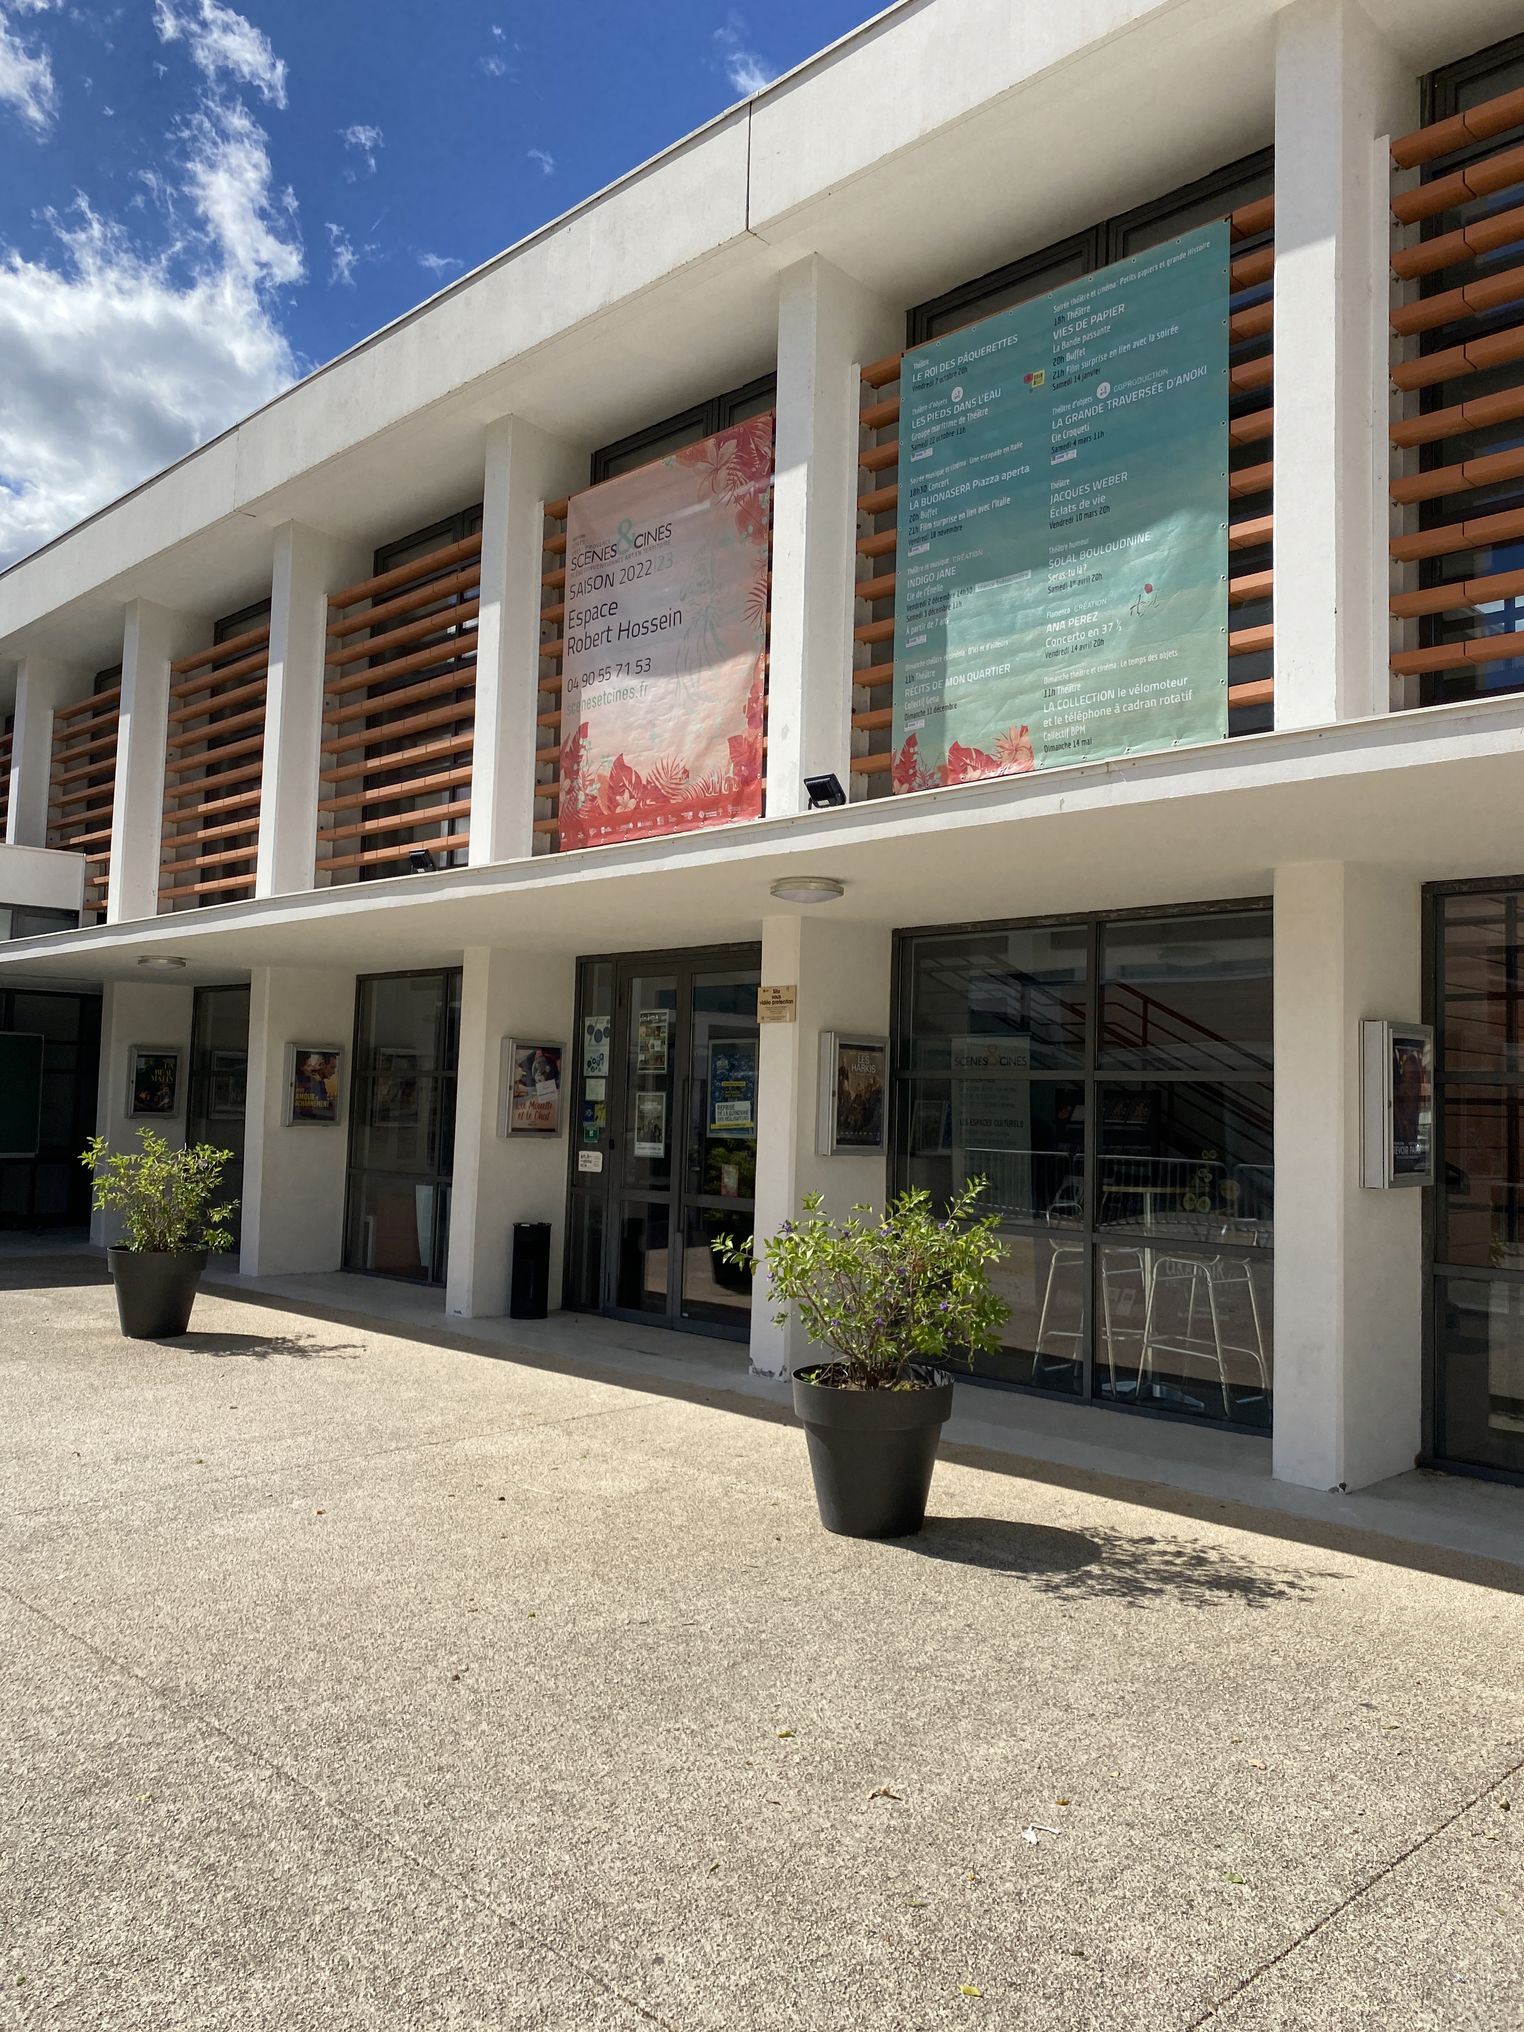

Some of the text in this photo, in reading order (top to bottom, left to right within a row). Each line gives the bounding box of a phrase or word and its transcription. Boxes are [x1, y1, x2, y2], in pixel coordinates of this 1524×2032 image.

[1053, 302, 1124, 340] VIES DE PAPIER
[1054, 305, 1090, 326] 18h Théâtre
[1052, 325, 1110, 353] La Bande passante
[1052, 367, 1064, 380] 21h
[1066, 363, 1079, 375] Film
[1081, 353, 1107, 369] surprise
[1109, 348, 1117, 358] en
[1118, 343, 1130, 354] lien
[1132, 336, 1146, 349] avec
[1148, 333, 1154, 343] la
[1156, 324, 1178, 340] soirée
[912, 333, 1017, 383] LE ROI DES PÂQUERETTES
[1053, 346, 1085, 367] 20h Buffet
[1052, 376, 1072, 391] Samedi
[1074, 373, 1080, 383] 14
[1081, 367, 1100, 382] janvier
[911, 415, 925, 429] LES
[926, 405, 951, 424] PIEDS
[953, 396, 976, 414] DANS
[978, 387, 1001, 405] L'EAU
[1052, 416, 1063, 430] LA
[1065, 401, 1103, 425] GRANDE
[1107, 381, 1163, 410] TRAVERSÉE
[1166, 364, 1206, 389] D'ANOKI
[1051, 429, 1104, 454] Samedi 4 mars 11h
[909, 464, 1029, 511] LA BUONASERA Piazza aperta
[928, 477, 949, 492] Concert
[1050, 470, 1127, 504] JACQUES WEBER
[1049, 504, 1110, 530] Vendredi 10 mars 20h
[1050, 493, 1105, 519] Éclats de vie
[570, 544, 617, 571] SCENES
[616, 514, 635, 557] &
[633, 521, 672, 550] CINES
[1048, 530, 1151, 569] SOLAL BOULOUDNINE
[569, 571, 614, 601] SAISON
[907, 572, 934, 589] INDIGO
[936, 565, 956, 581] JANE
[568, 599, 617, 629] Espace
[1045, 611, 1097, 633] ANA PEREZ
[567, 605, 682, 656] Robert Hossein
[1045, 631, 1085, 648] Concerto
[1087, 627, 1098, 637] en
[1101, 622, 1112, 634] 37
[1045, 637, 1104, 659] Vendredi 14 avril 20h
[567, 656, 651, 693] 04 90 55 71 53
[905, 662, 1010, 697] RÉCITS DE MON QUARTIER
[566, 679, 648, 717] scenesetcines.fr
[1043, 676, 1188, 713] LA COLLECTION le vélomoteur
[1044, 683, 1080, 698] 11h Théâtre
[1043, 688, 1192, 727] et le téléphone à cadran rotatif
[1043, 724, 1085, 740] Collectif BPM
[1043, 736, 1092, 753] Dimanche 14 mai
[851, 1064, 876, 1073] HARKIS
[857, 1055, 870, 1064] LES
[954, 1044, 1027, 1066] SCENES & CINES
